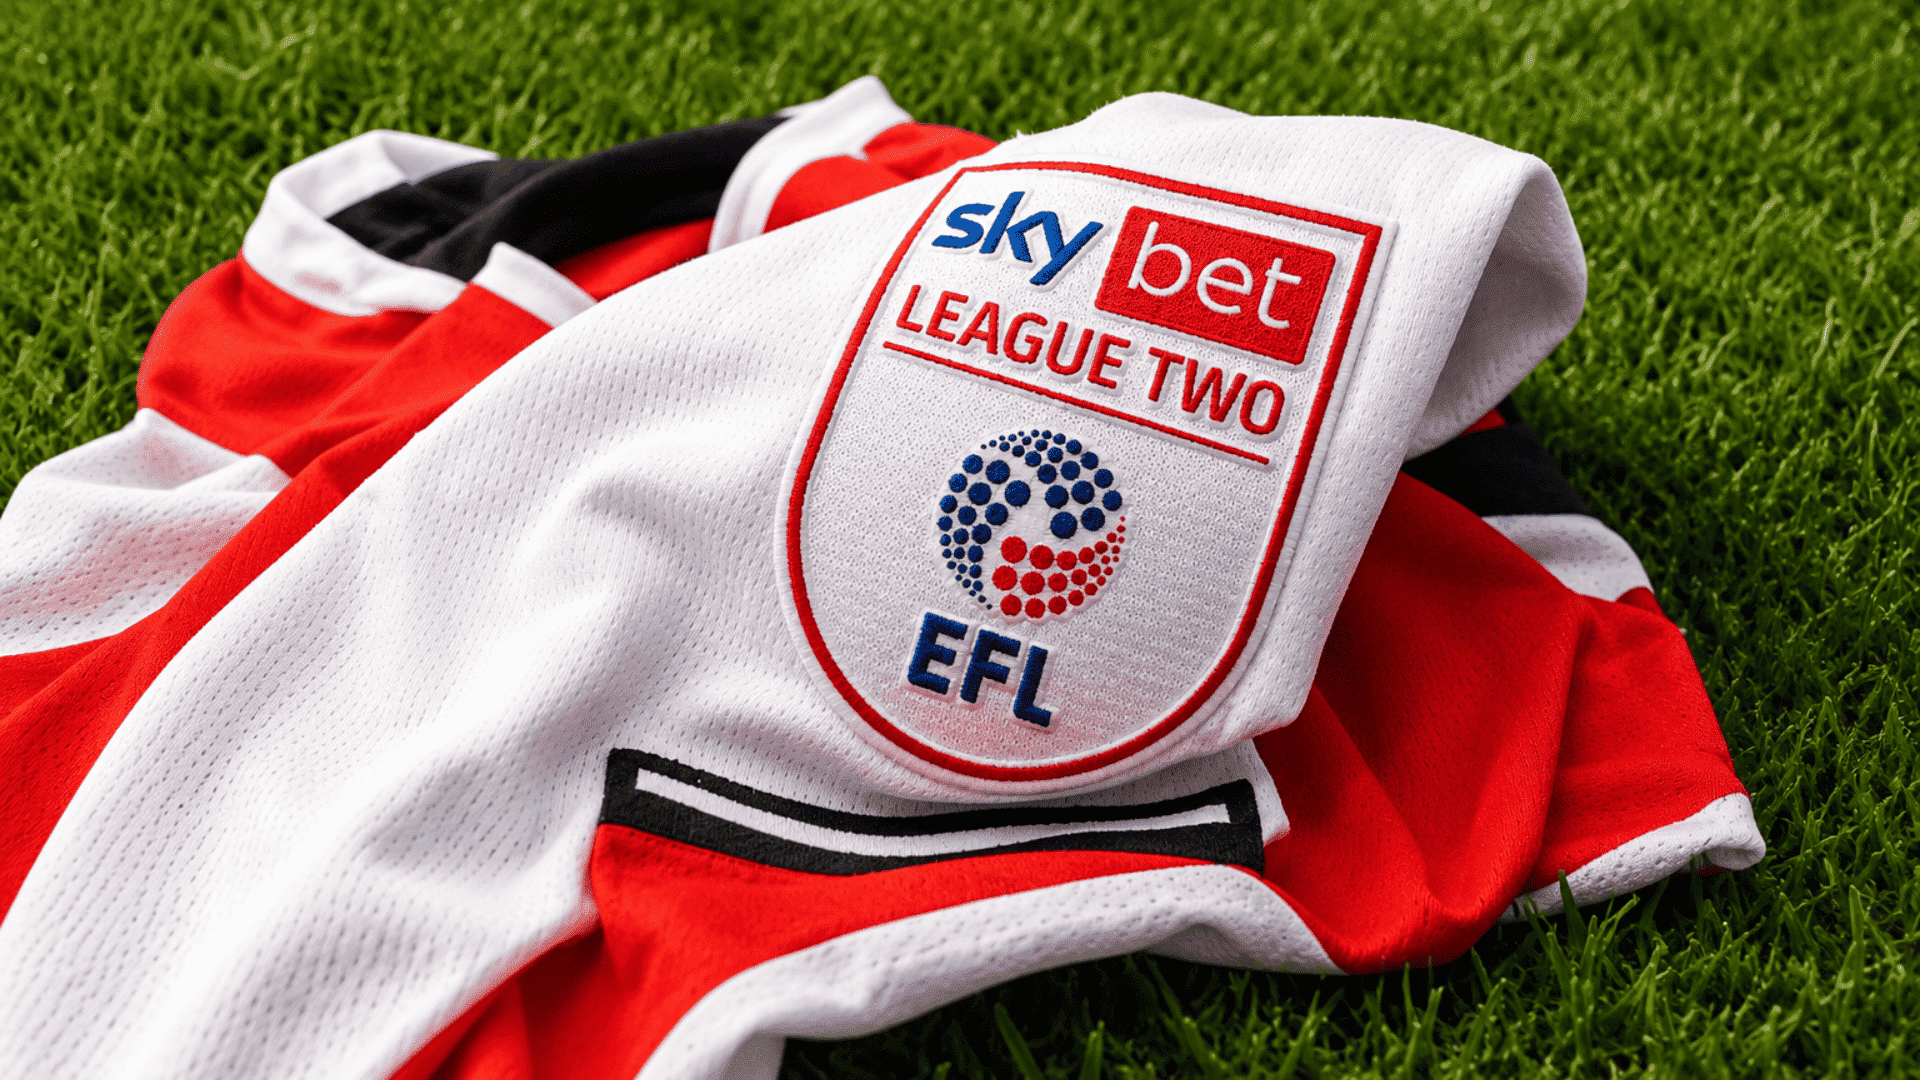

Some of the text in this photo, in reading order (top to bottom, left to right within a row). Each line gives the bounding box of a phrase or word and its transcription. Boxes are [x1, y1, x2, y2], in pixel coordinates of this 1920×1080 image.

[932, 191, 1302, 329] sky bet
[896, 285, 1286, 436] LEAGUE TWO
[907, 611, 1052, 728] EFL
